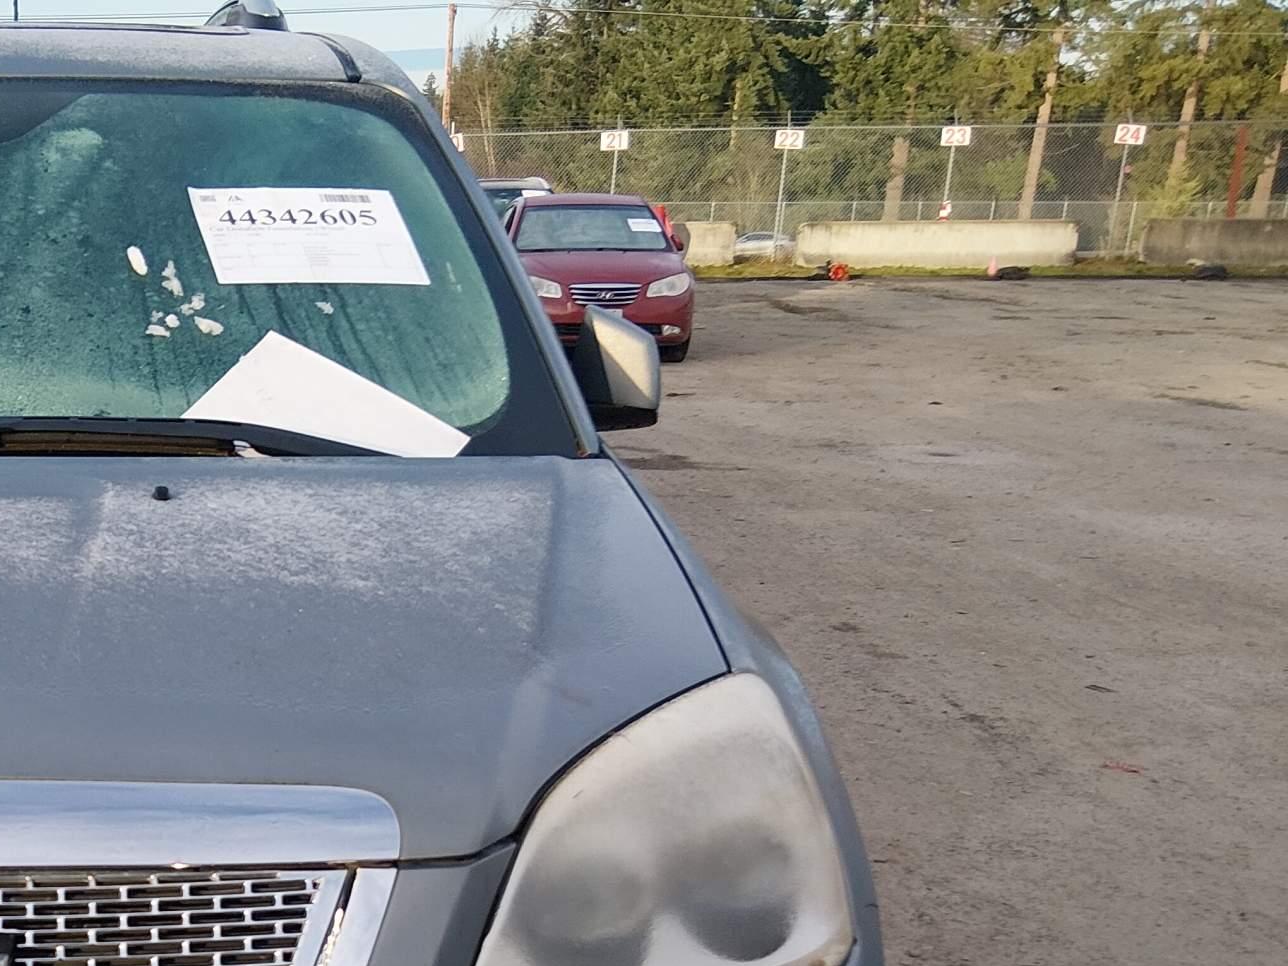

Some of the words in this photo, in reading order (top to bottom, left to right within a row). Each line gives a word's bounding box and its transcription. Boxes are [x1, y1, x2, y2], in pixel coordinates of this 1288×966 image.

[606, 132, 623, 149] 21
[778, 131, 800, 148] 22
[944, 127, 967, 144] 23
[1117, 126, 1141, 144] 24
[219, 207, 377, 227] 44342605
